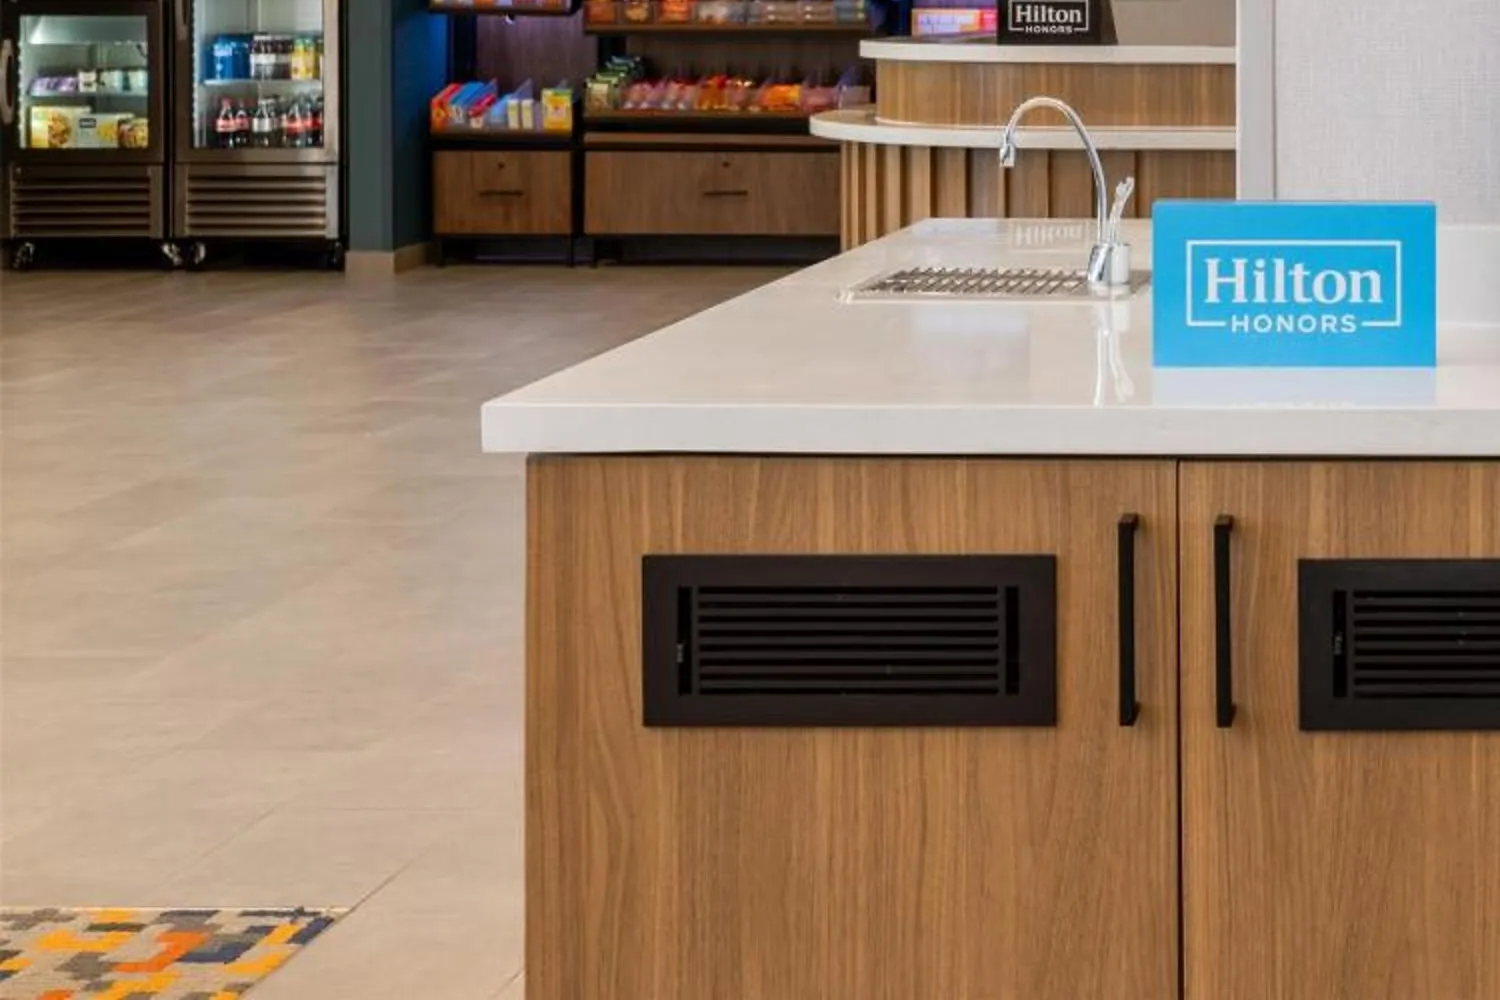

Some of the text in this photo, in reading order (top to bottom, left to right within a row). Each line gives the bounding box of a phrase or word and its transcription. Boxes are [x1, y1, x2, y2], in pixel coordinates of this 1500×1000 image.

[1015, 4, 1083, 23] Hilton
[1204, 257, 1384, 304] Hilton
[1231, 314, 1357, 333] HONORS
